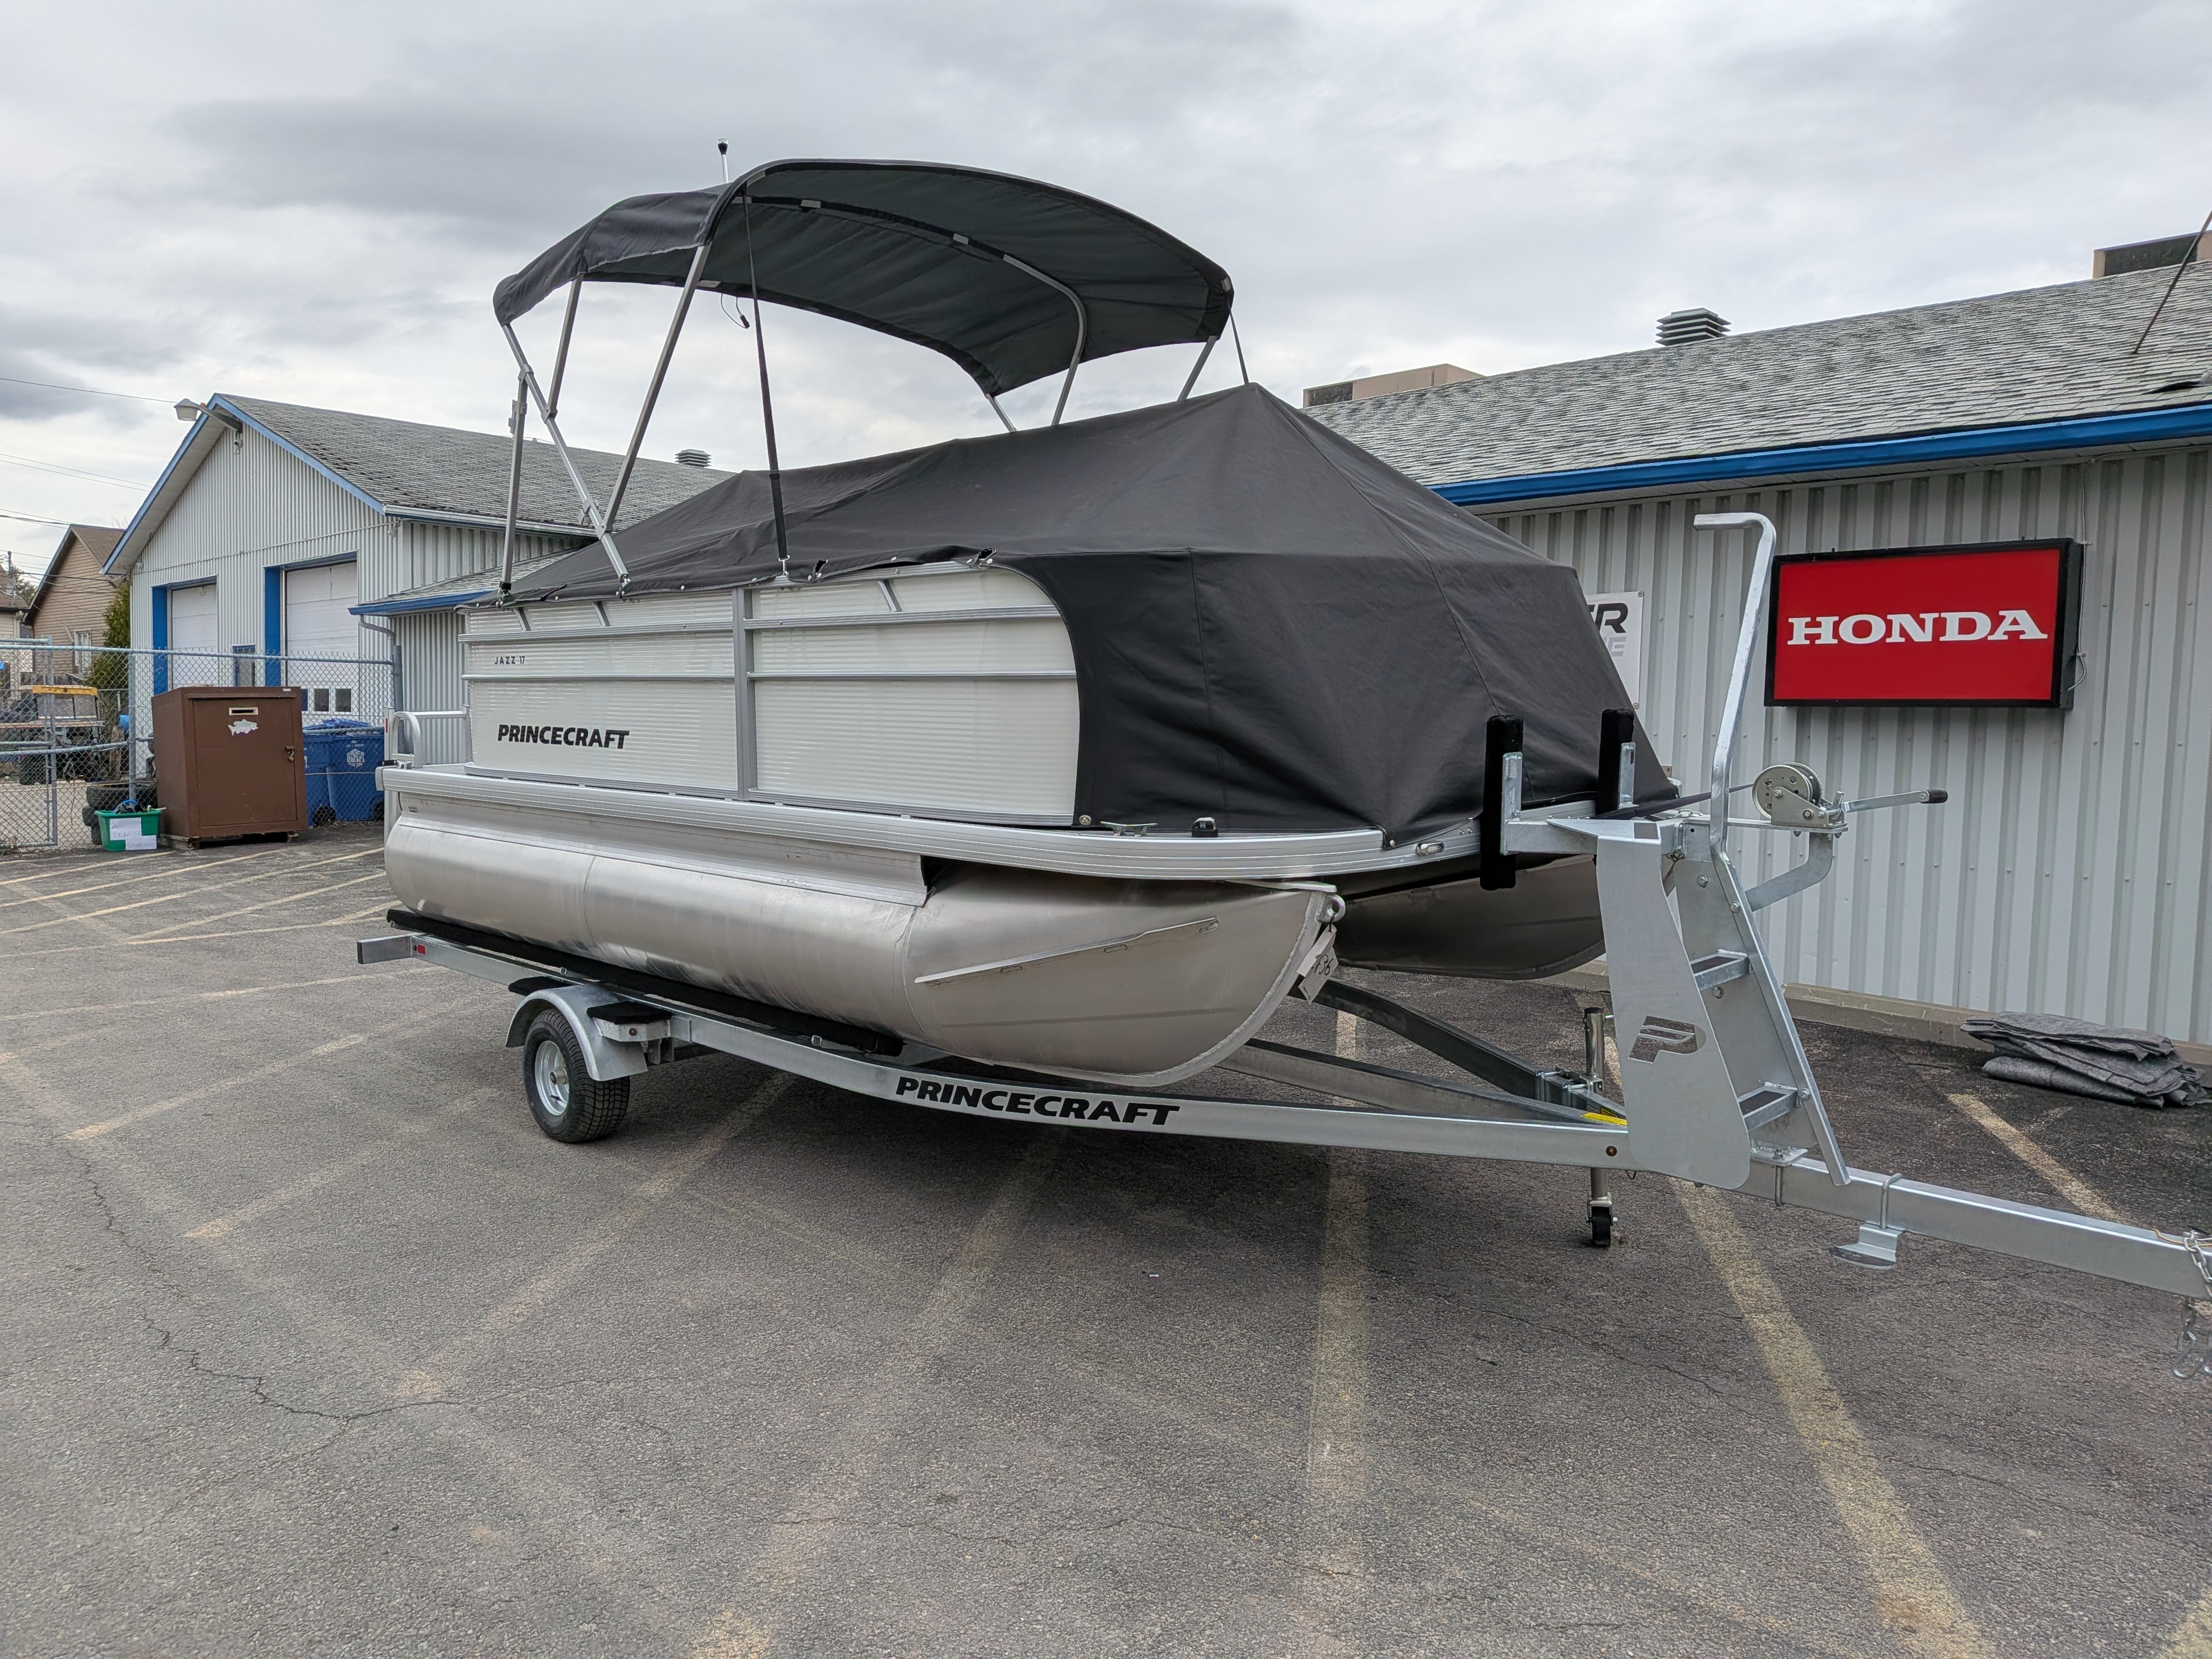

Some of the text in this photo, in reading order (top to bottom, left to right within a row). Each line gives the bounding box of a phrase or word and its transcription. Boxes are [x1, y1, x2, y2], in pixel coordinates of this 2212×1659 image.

[1787, 610, 2048, 645] HONDA
[494, 656, 525, 665] JAZZ 17
[498, 724, 630, 749] PRINCECRAFT
[896, 1076, 1180, 1125] PRINCECRAFT
